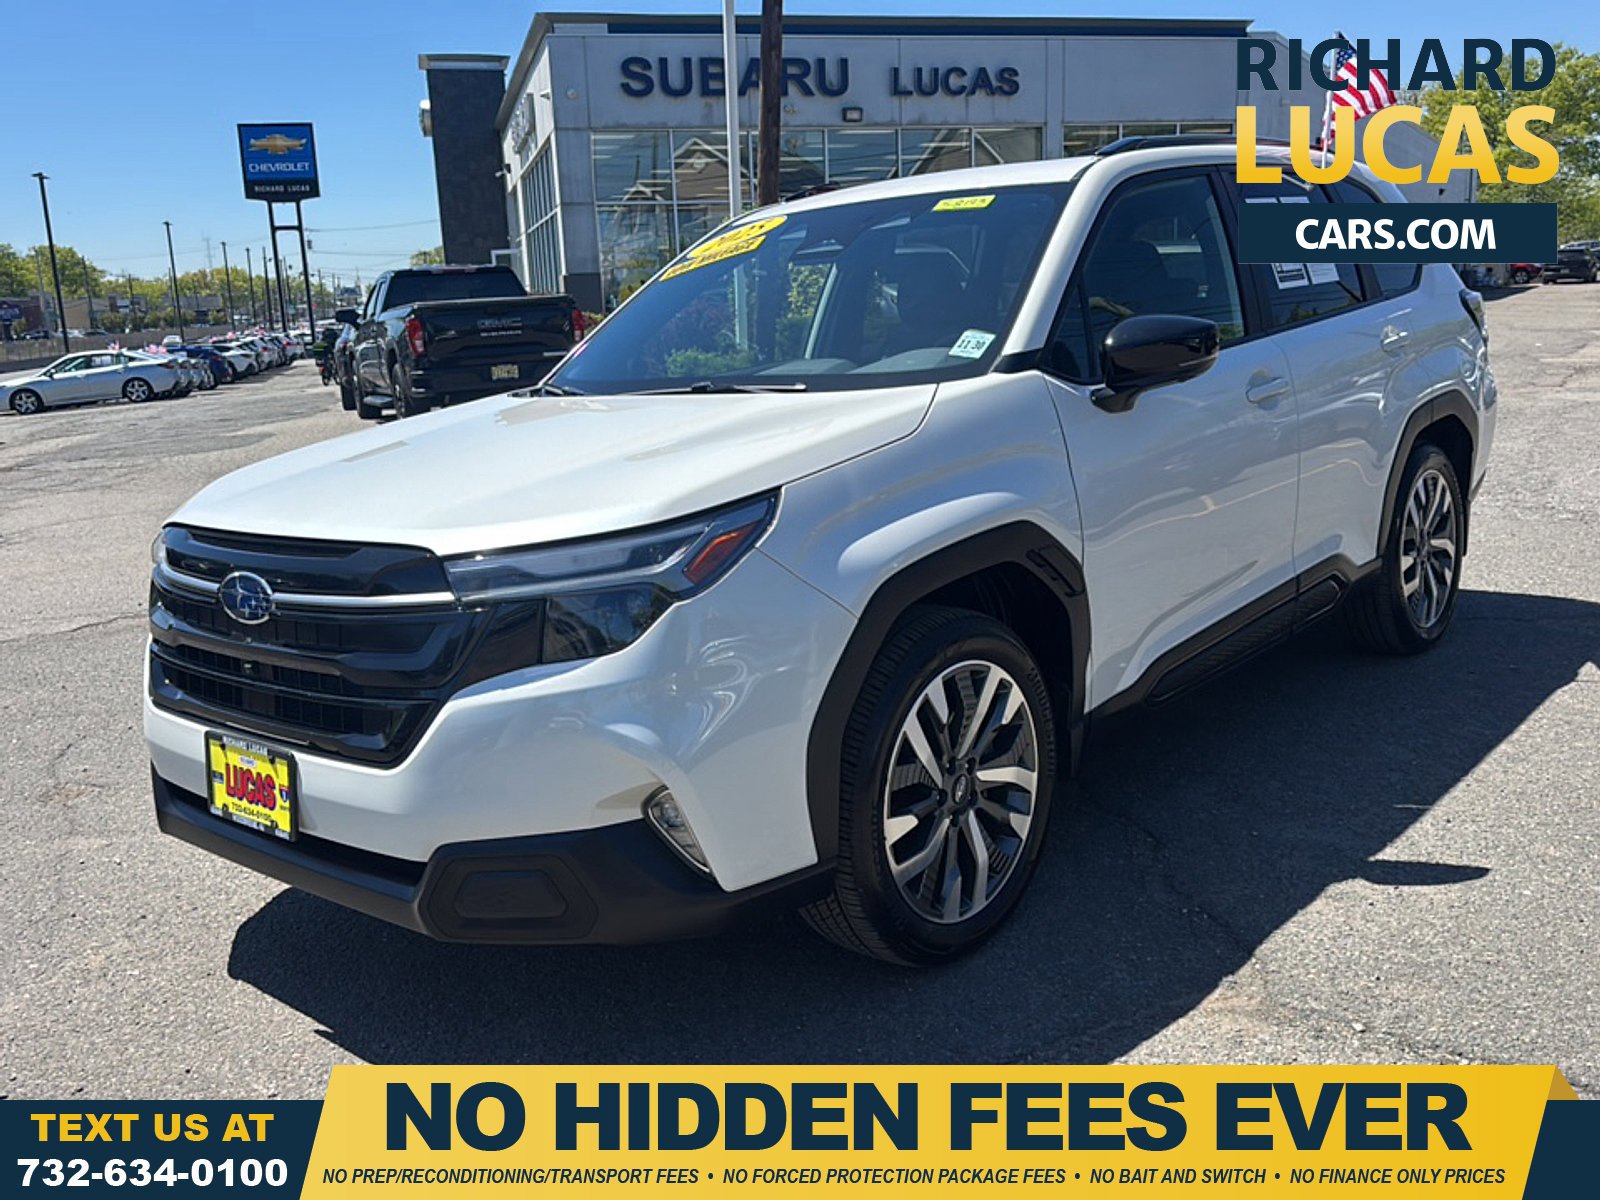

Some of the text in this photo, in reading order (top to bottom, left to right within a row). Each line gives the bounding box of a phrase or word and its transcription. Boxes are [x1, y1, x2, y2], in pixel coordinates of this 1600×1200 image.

[620, 56, 1020, 97] SUBARU LUCAS
[248, 162, 309, 173] CHEVROLET
[254, 184, 310, 192] RICHARD LUCAS
[225, 762, 277, 811] LUCAS
